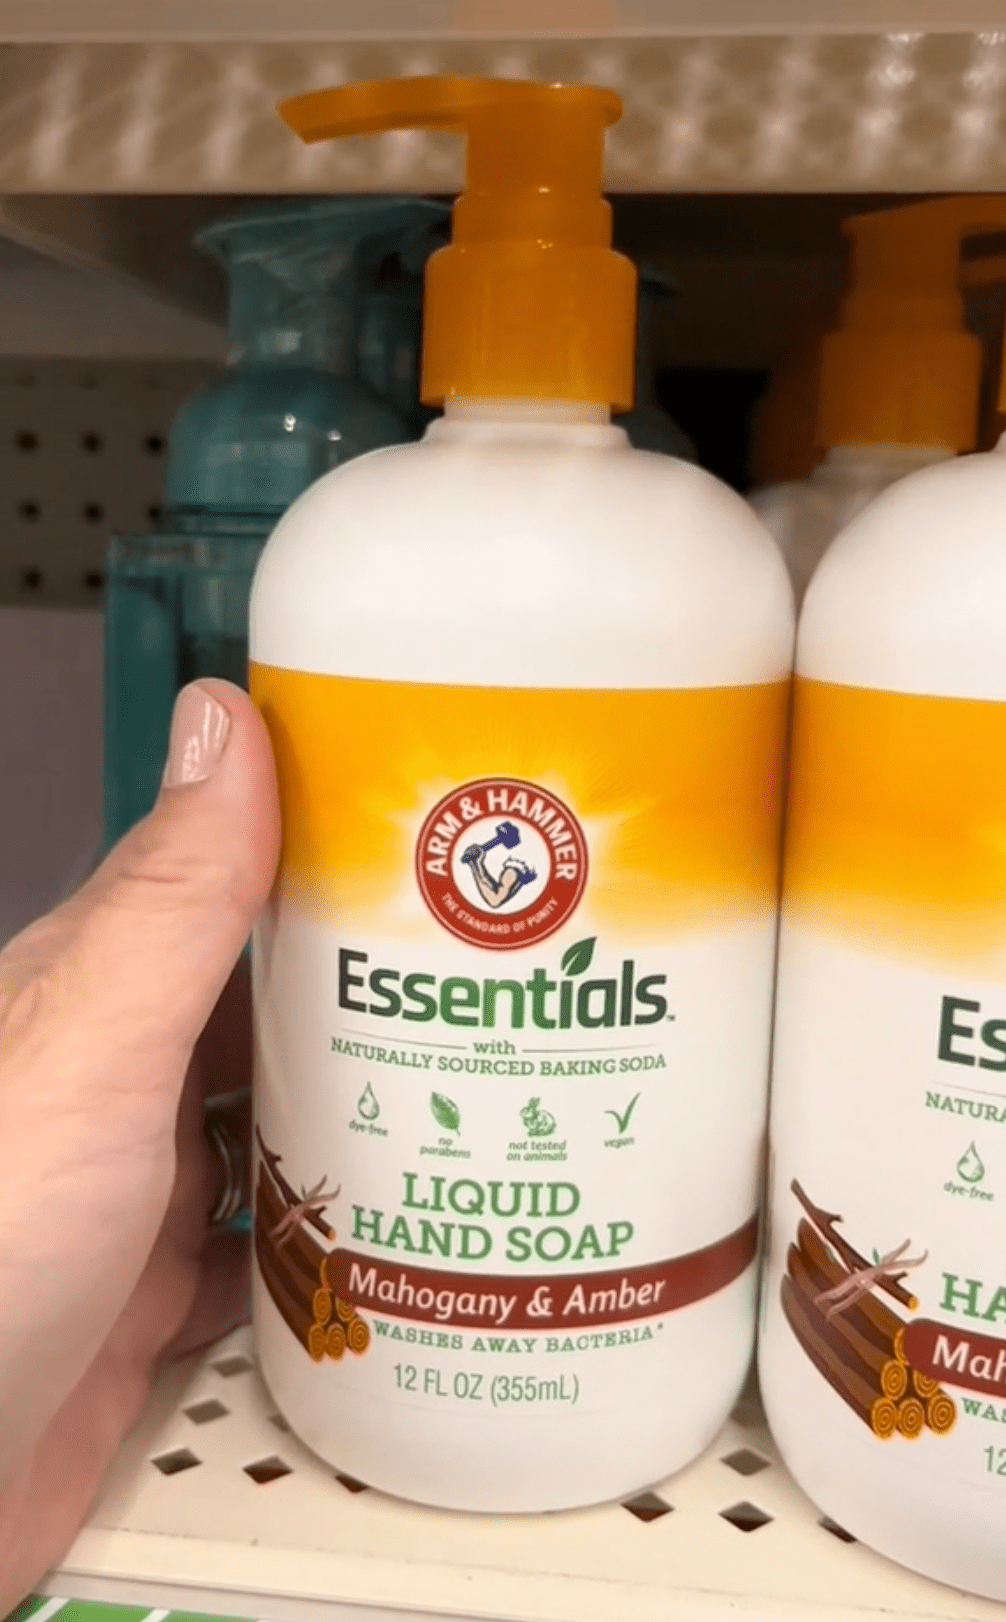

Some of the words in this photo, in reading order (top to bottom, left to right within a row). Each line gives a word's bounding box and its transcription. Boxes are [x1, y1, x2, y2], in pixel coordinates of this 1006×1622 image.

[426, 811, 463, 877] ARM
[459, 796, 484, 821] &
[486, 788, 578, 881] HAMMER
[455, 909, 511, 935] STANDARD
[512, 920, 526, 933] OF
[526, 897, 558, 927] PURITY
[338, 947, 667, 1029] Essentials
[331, 1037, 433, 1069] NATURALLY
[437, 1056, 535, 1076] SOURCED
[539, 1058, 616, 1076] BAKING
[618, 1053, 667, 1073] SODA
[473, 1040, 516, 1055] with
[349, 1119, 389, 1137] dye-free
[438, 1137, 453, 1146] no
[603, 1137, 635, 1149] vegan
[419, 1145, 472, 1160] parabens
[506, 1152, 521, 1161] on
[523, 1151, 568, 1161] animals
[509, 1141, 528, 1150] not
[531, 1139, 567, 1151] tested
[402, 1172, 581, 1218] LIQUID
[943, 1180, 994, 1202] dye-free
[351, 1204, 492, 1261] HAND
[505, 1221, 634, 1262] SOAP
[349, 1263, 517, 1325] Mahogany
[526, 1286, 554, 1317] &
[562, 1277, 667, 1316] Amber
[372, 1320, 463, 1349] WASHES
[471, 1337, 538, 1353] AWAY
[394, 1363, 418, 1391] 12
[424, 1368, 448, 1397] FL
[453, 1372, 484, 1400] OZ
[490, 1374, 580, 1407] (355mL)
